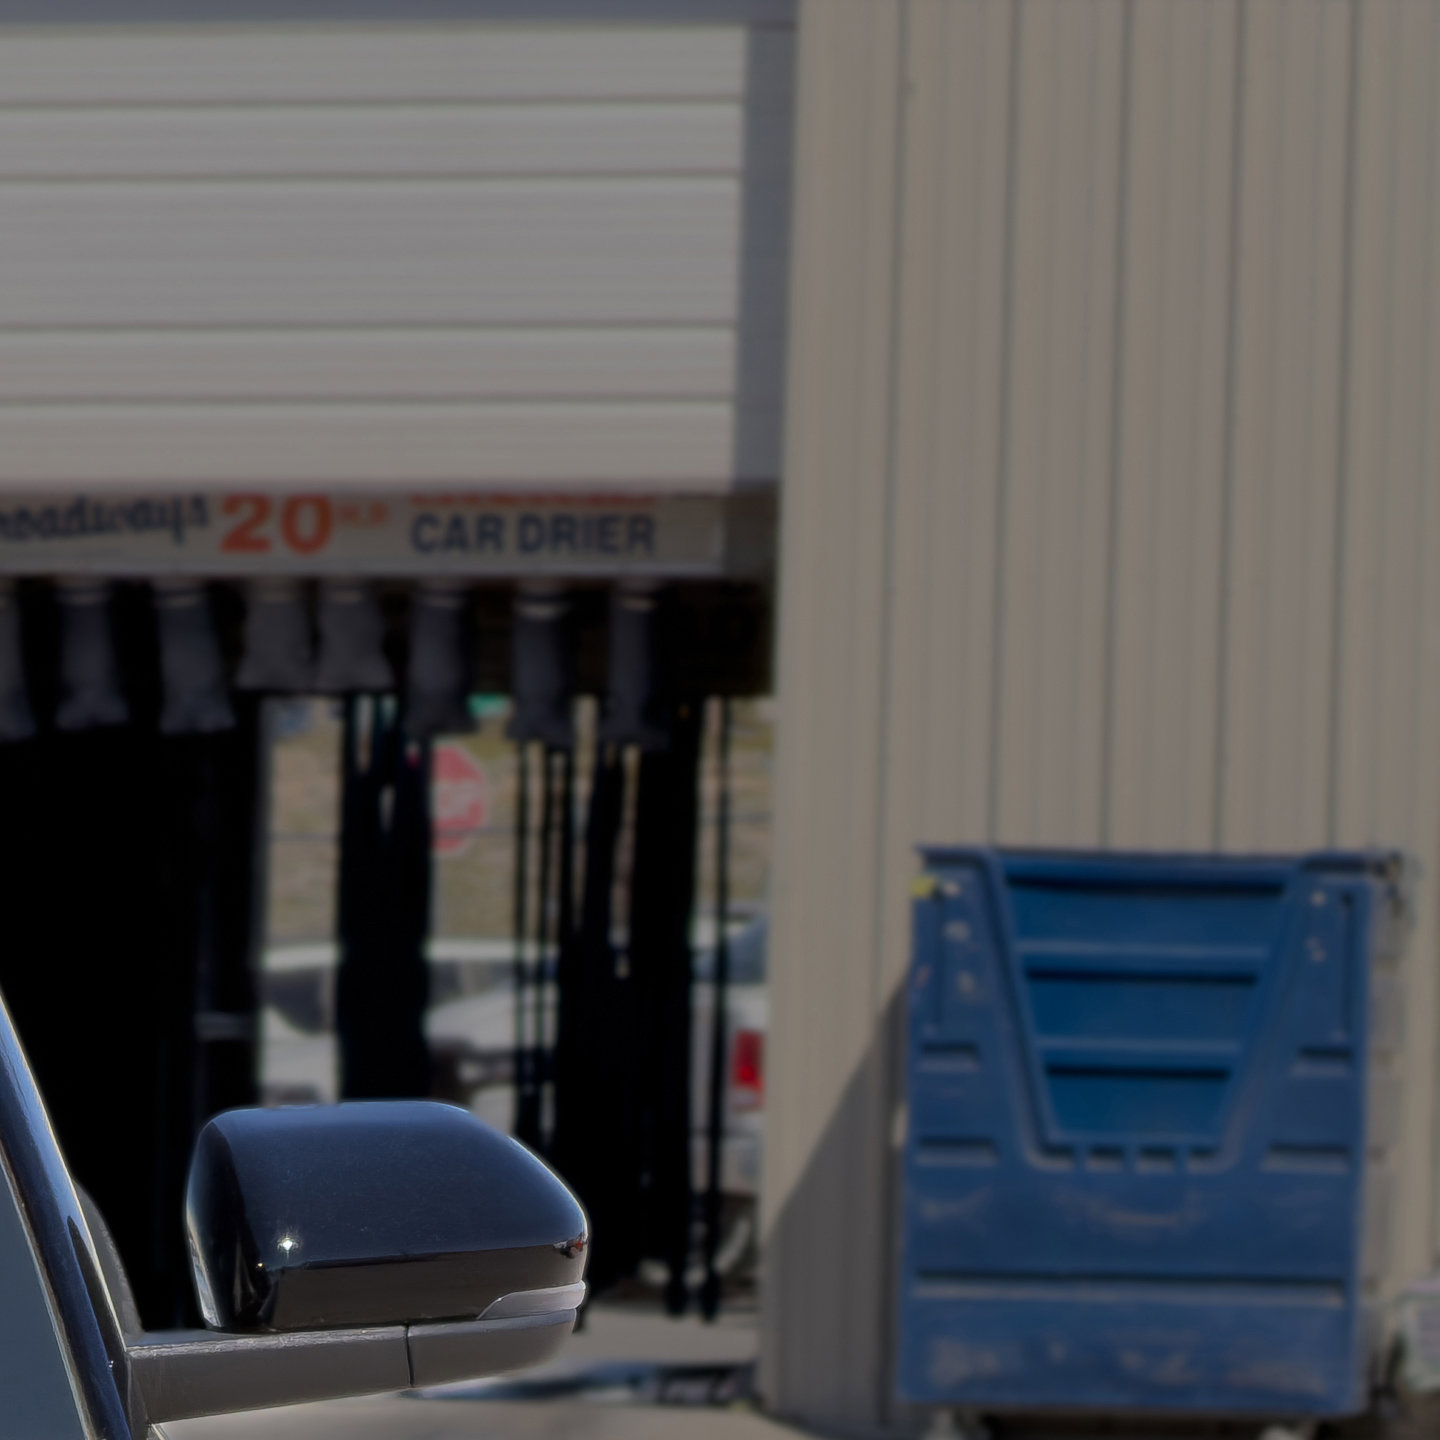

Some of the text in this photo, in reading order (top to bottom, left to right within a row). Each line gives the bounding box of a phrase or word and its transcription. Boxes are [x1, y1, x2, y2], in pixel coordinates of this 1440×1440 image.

[218, 493, 336, 557] 20
[410, 512, 505, 555] CAR
[516, 512, 657, 555] DRIER
